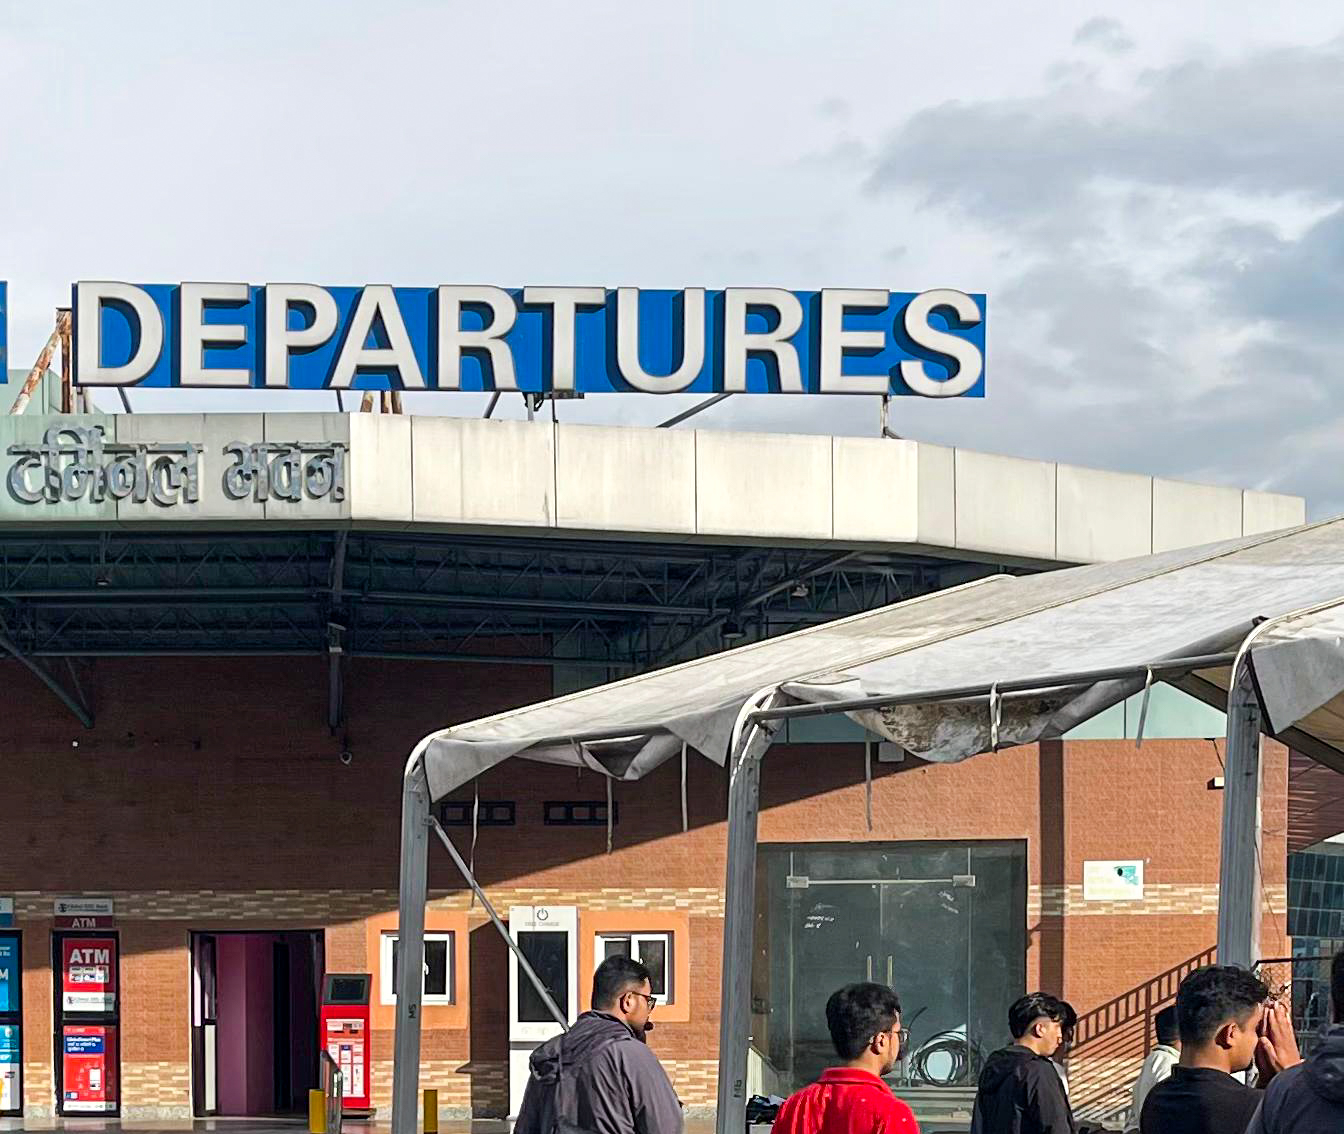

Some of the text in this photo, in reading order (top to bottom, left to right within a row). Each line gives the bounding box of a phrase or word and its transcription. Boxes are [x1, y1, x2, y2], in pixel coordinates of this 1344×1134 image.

[73, 280, 984, 399] DEPARTURES
[223, 440, 350, 504] भवन
[71, 917, 97, 929] ATM
[69, 948, 110, 964] ATM
